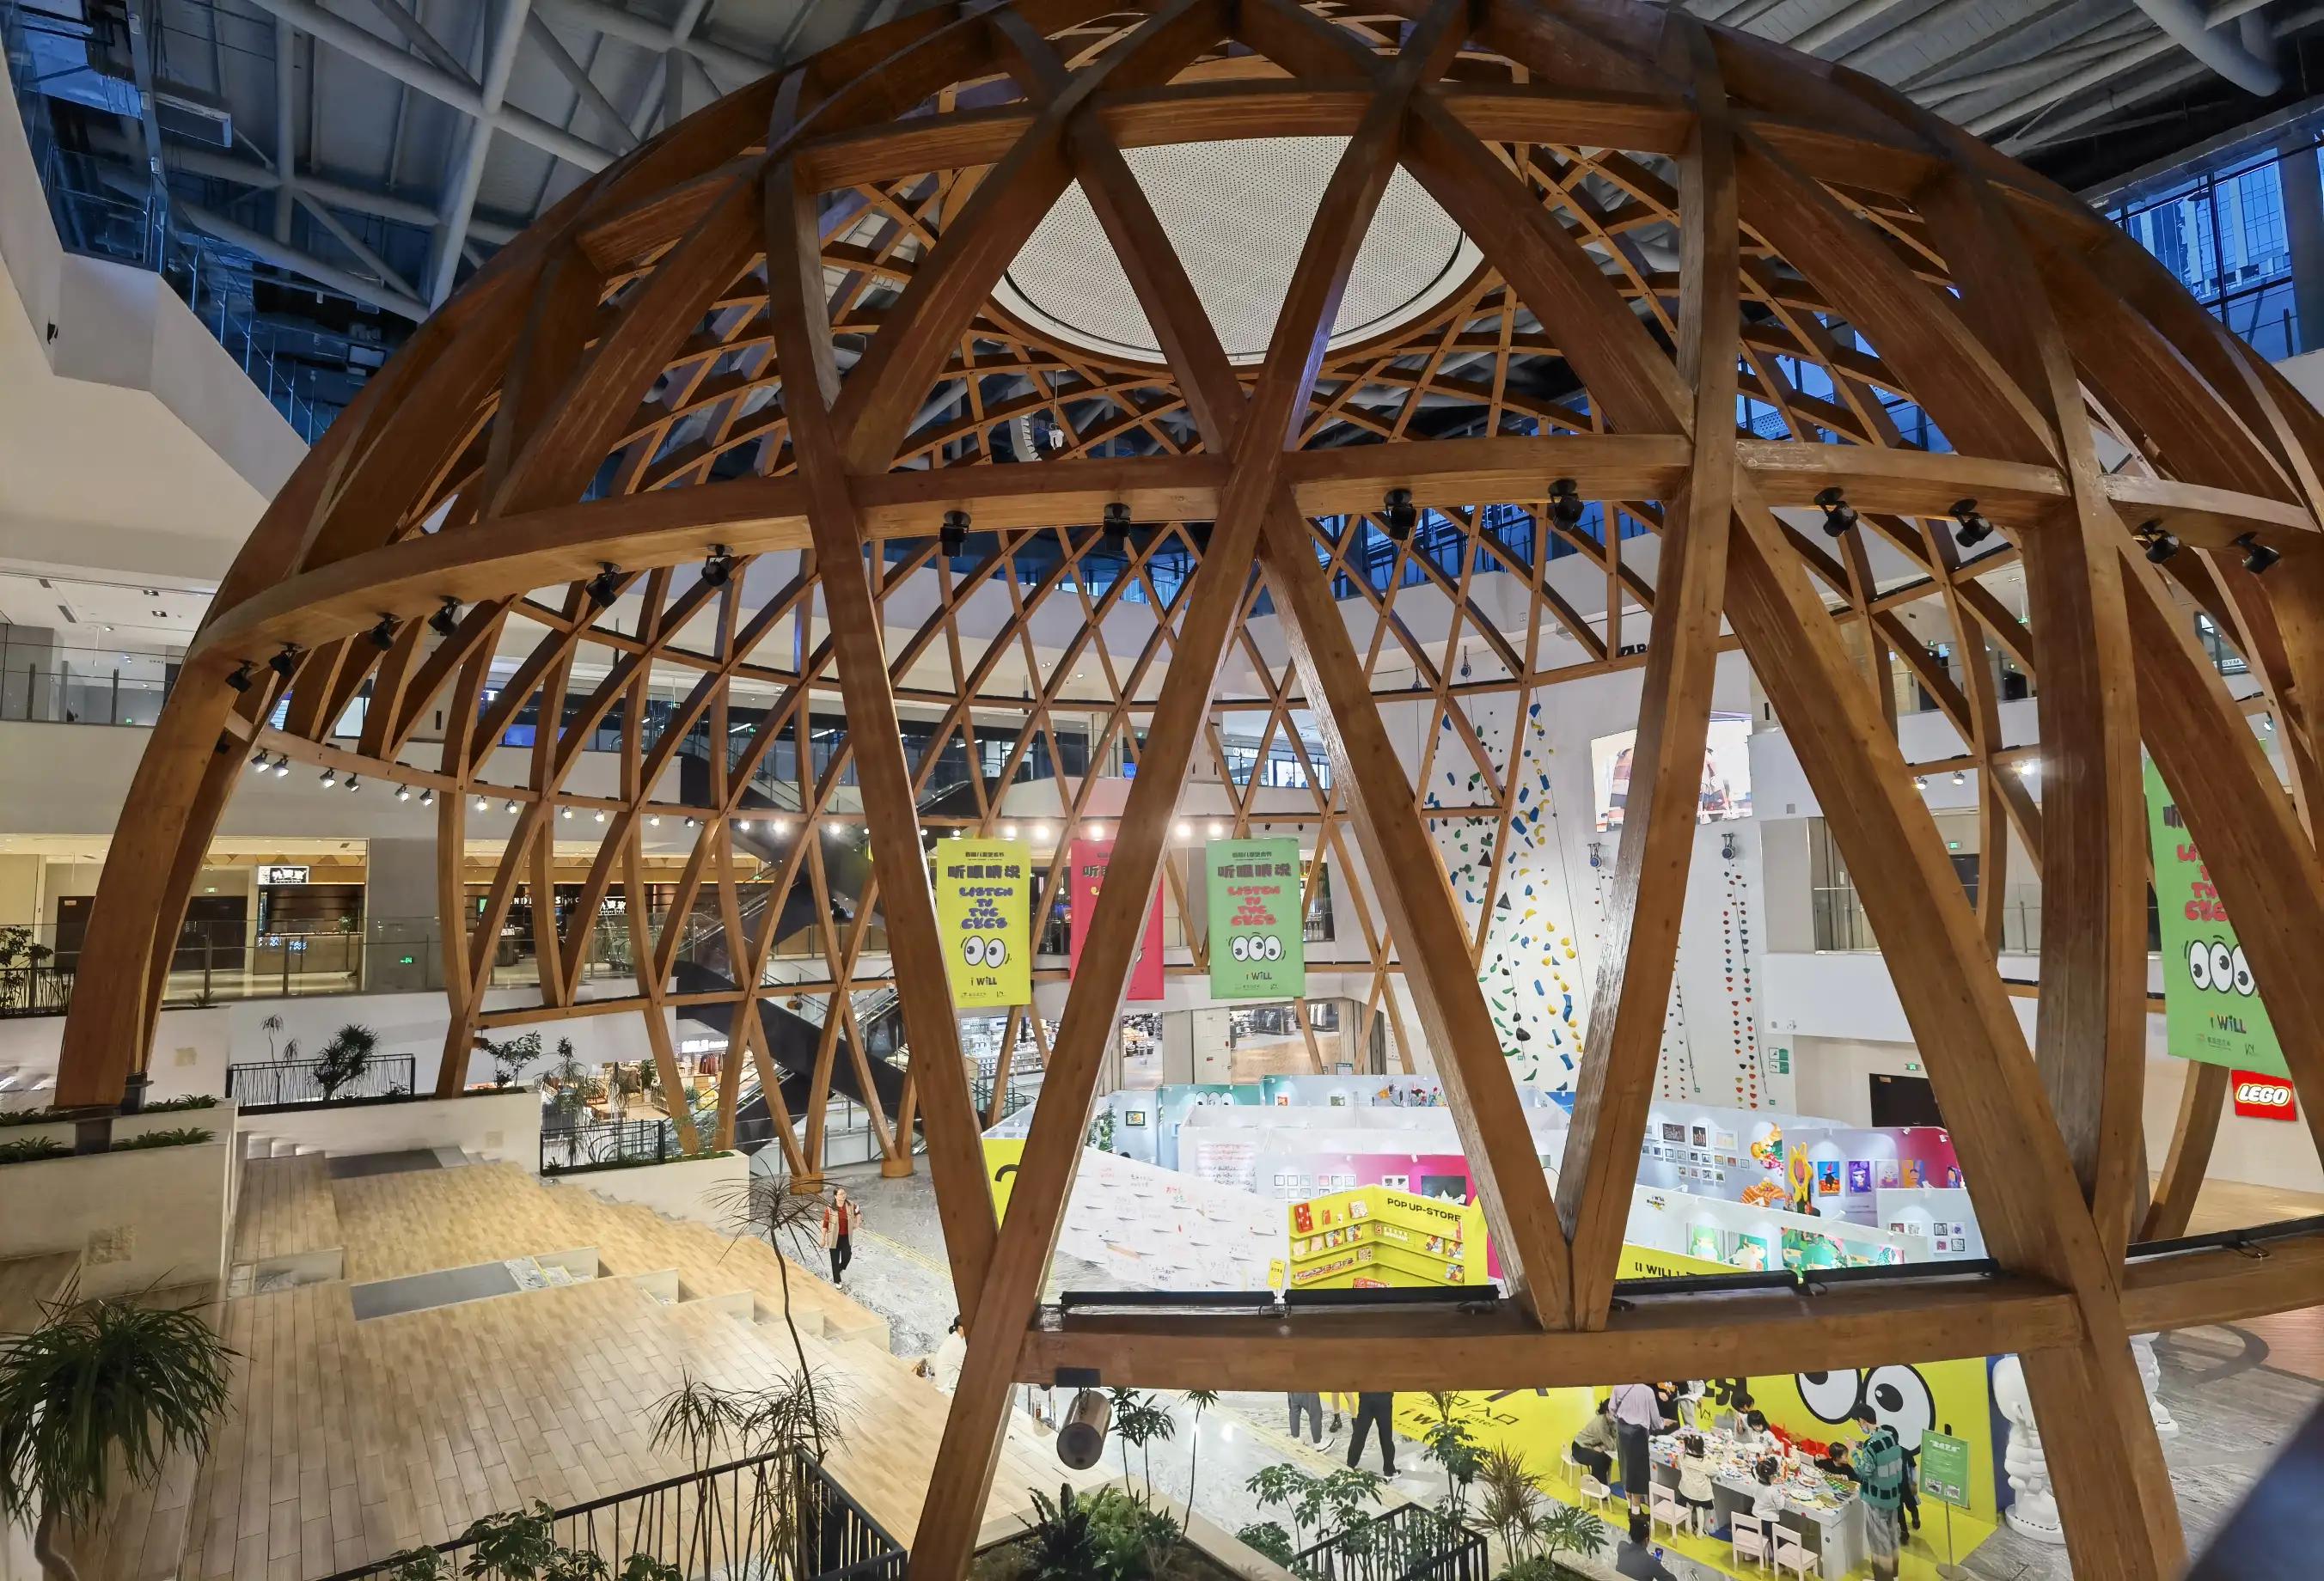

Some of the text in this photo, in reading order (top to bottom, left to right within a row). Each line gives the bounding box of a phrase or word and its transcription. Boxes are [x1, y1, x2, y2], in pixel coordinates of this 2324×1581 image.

[947, 864, 1021, 879] 听眼睛说
[1217, 863, 1292, 878] 听眼睛说
[958, 886, 1013, 897] LISTEN
[1226, 885, 1281, 896] LISTEN
[968, 907, 1000, 918] THE
[1237, 905, 1267, 915] THE
[2184, 900, 2229, 922] EYE
[960, 917, 1008, 930] EYES
[1230, 913, 1277, 926] EYES
[2237, 1084, 2290, 1106] LEGO
[1386, 1197, 1462, 1223] POP UP-STORE
[1464, 1413, 1497, 1428] Enter
